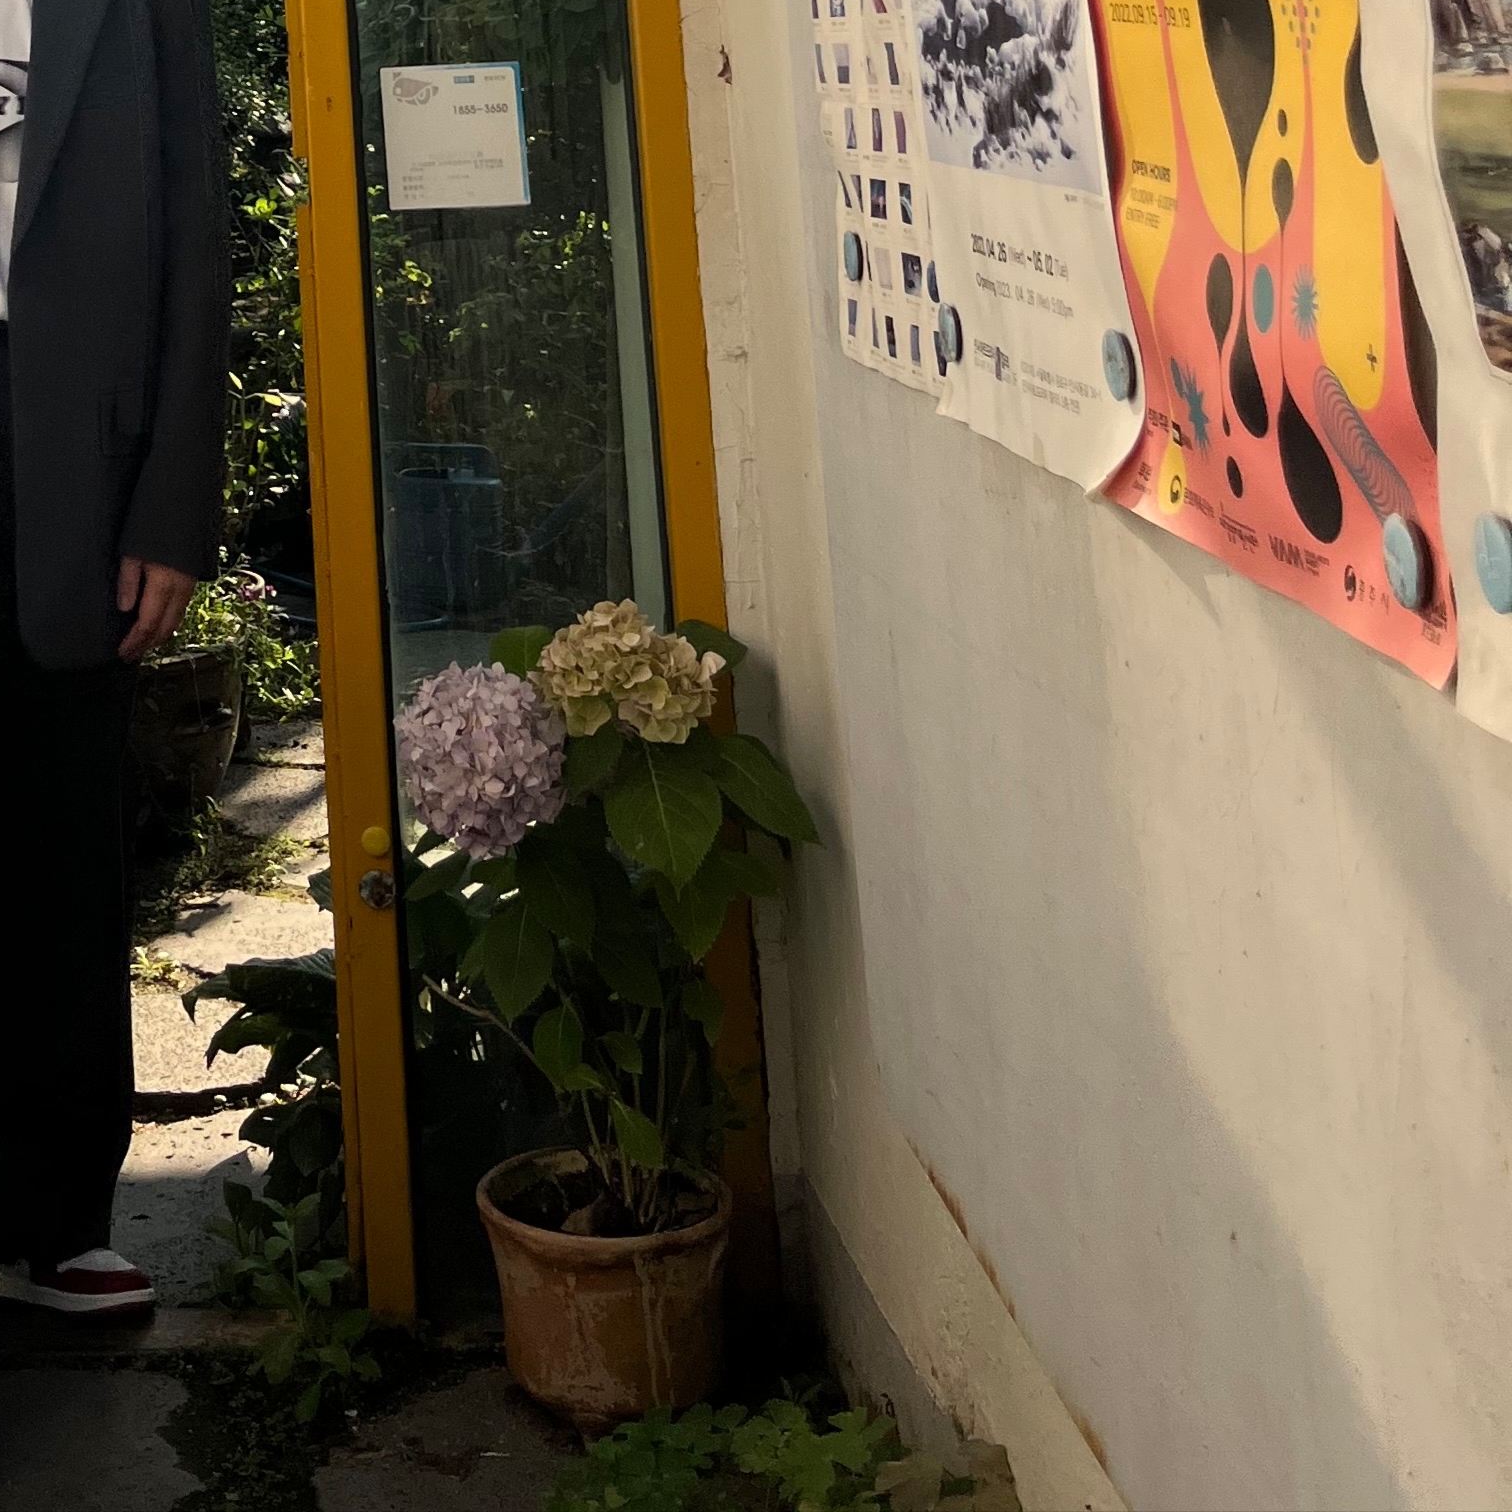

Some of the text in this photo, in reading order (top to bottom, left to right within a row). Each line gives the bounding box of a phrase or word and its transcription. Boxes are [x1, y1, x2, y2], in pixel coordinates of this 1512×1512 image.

[1108, 2, 1158, 26] 2022.09.15
[1163, 6, 1191, 28] 09.19
[452, 103, 509, 116] 1855-3650
[1131, 158, 1171, 183] OPEN HOURS
[1126, 207, 1144, 224] ENTRY
